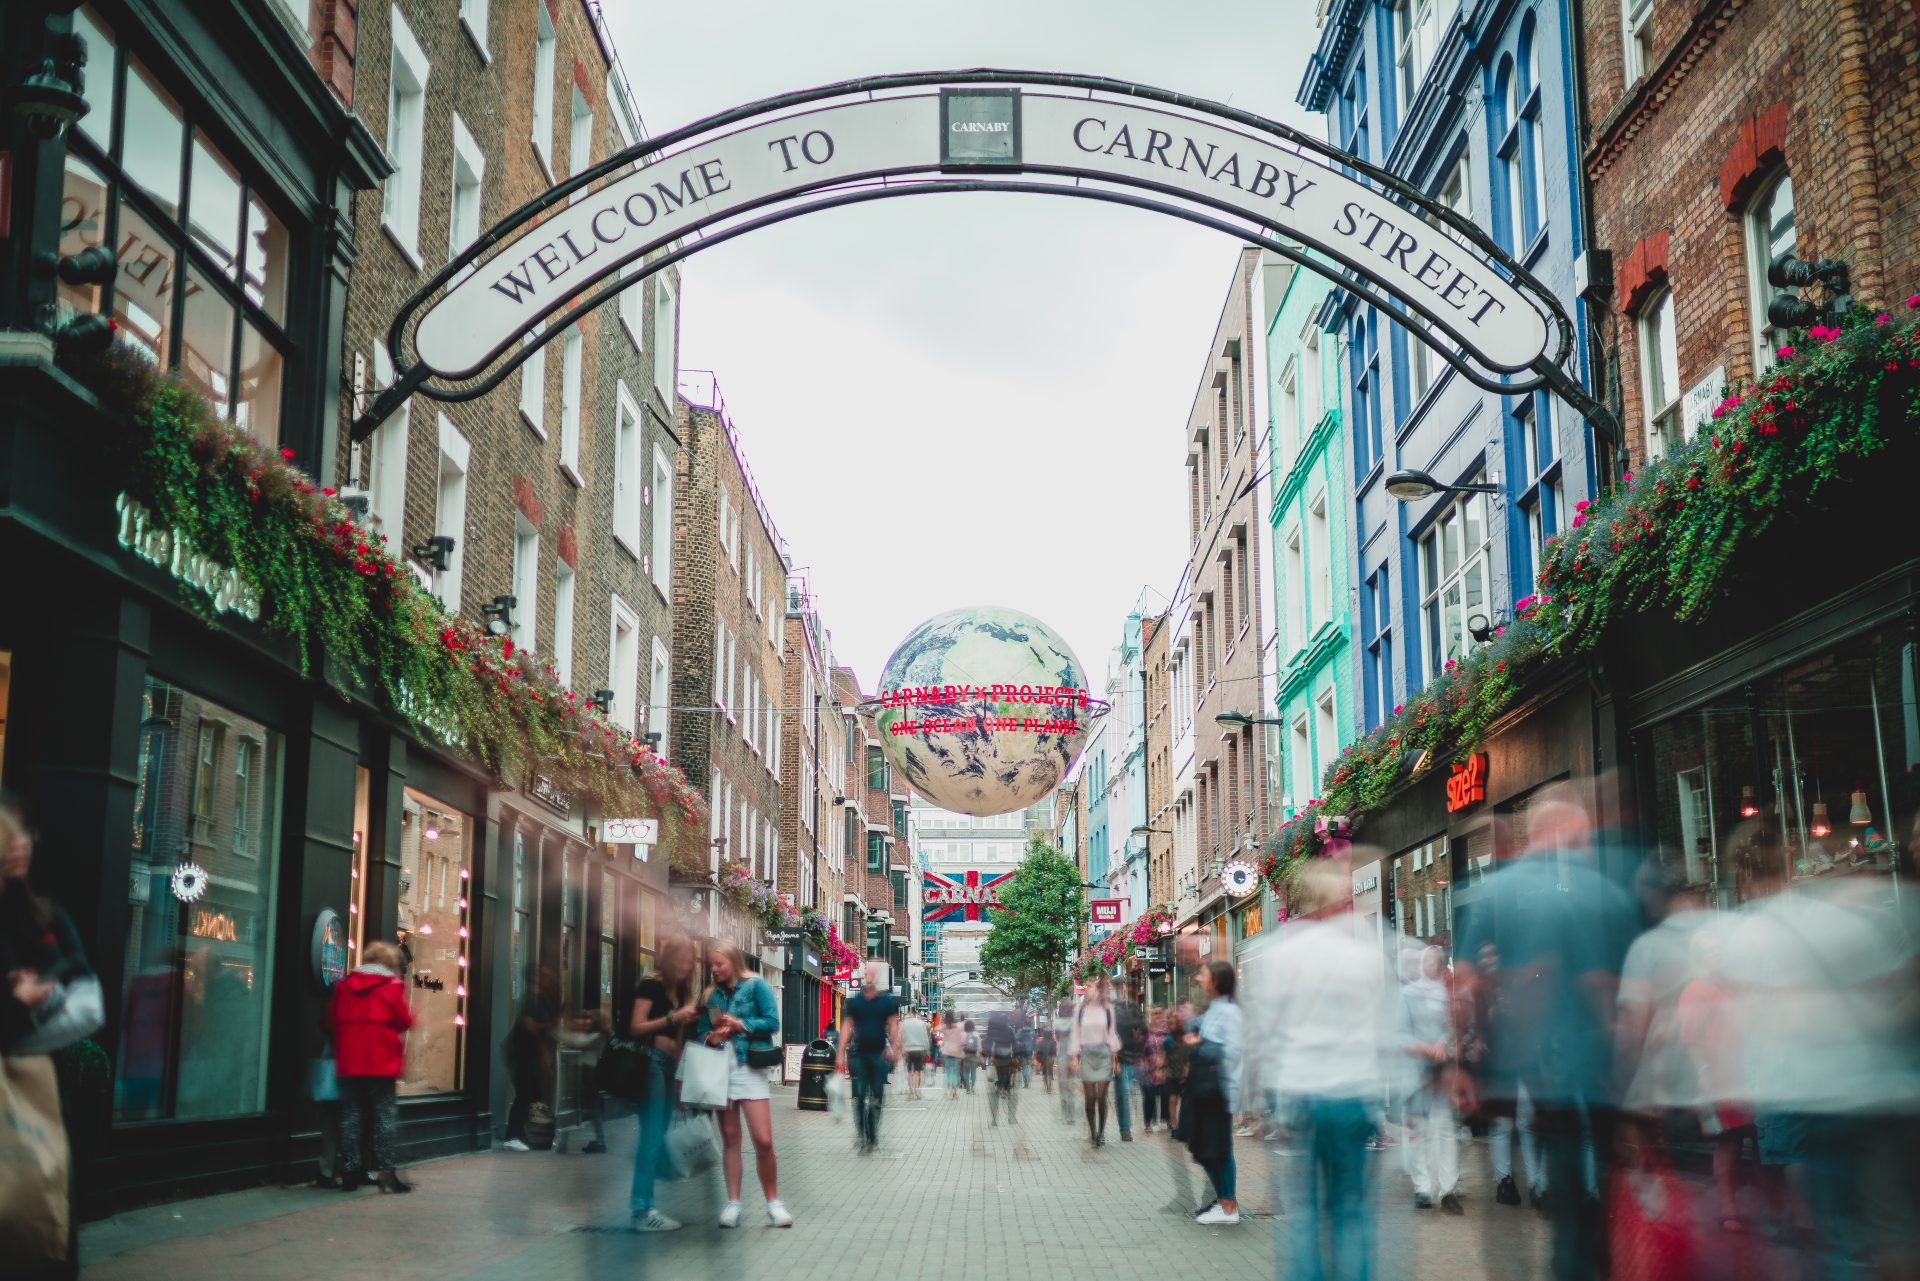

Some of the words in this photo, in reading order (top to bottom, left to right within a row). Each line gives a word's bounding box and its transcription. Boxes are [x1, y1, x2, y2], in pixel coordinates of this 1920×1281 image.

[951, 121, 1010, 133] CARNABY
[489, 158, 732, 306] WELCOME
[768, 129, 835, 173] TO
[1073, 117, 1317, 211] CARNABY
[1333, 201, 1506, 329] STREET
[881, 685, 970, 709] CARNABY
[991, 684, 1074, 707] PROJECT
[891, 719, 918, 737] ONE
[923, 717, 977, 735] OCEAN
[982, 717, 1017, 734] ONE
[1023, 717, 1078, 736] PLANET
[1447, 752, 1486, 813] size?
[1096, 906, 1117, 915] MUJI
[764, 930, 781, 941] Pepe
[779, 930, 800, 941] Jeans
